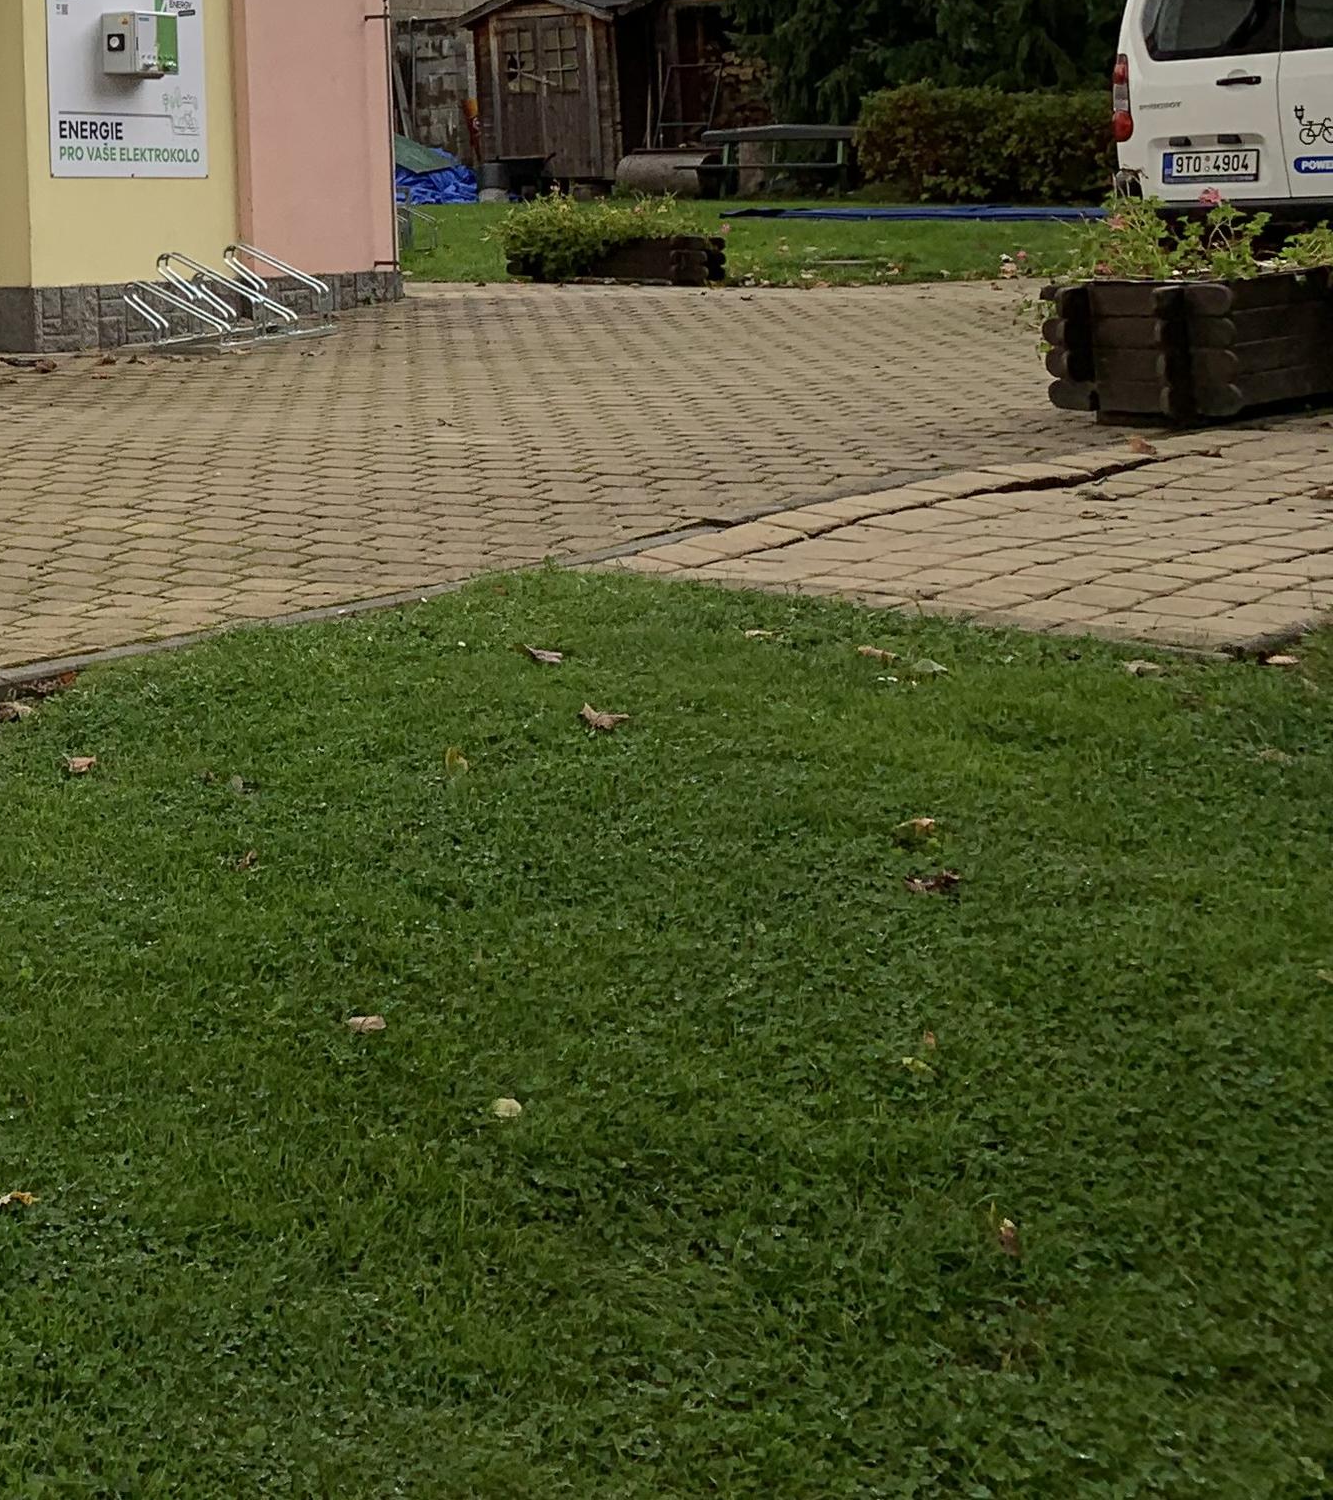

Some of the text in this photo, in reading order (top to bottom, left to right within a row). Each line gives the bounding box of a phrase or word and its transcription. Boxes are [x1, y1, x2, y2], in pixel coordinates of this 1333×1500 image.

[59, 120, 123, 140] ENERGIE
[59, 142, 200, 163] PRO VAŠE ELEKTROKOLO
[1213, 154, 1249, 172] 4904
